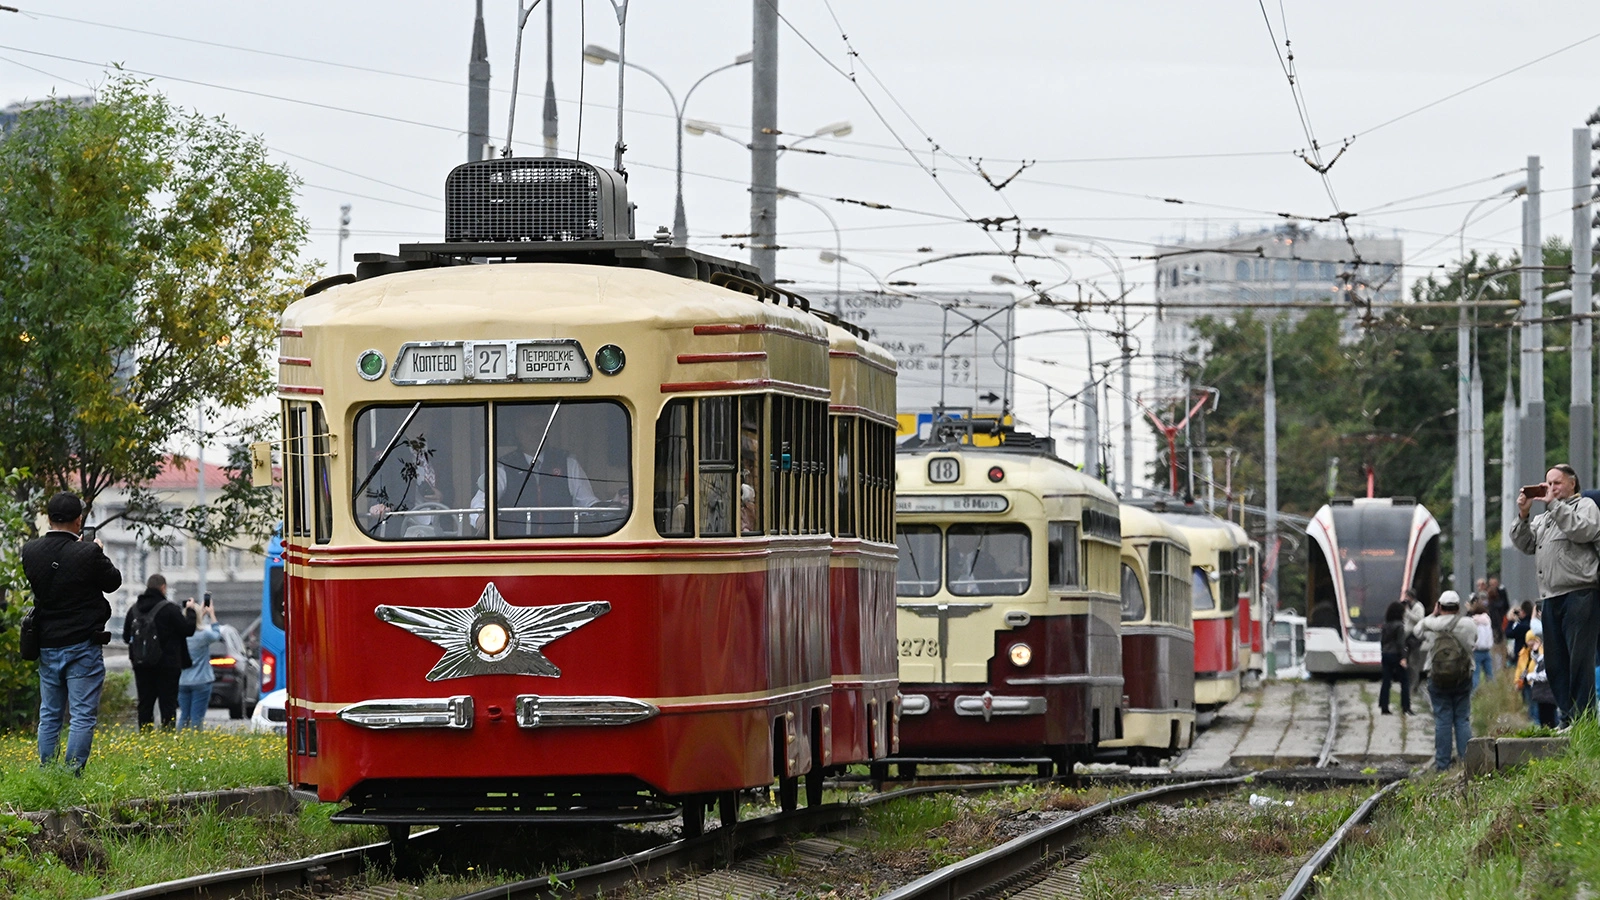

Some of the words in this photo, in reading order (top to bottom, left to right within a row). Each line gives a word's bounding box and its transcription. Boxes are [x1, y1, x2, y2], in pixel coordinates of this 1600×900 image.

[479, 350, 502, 373] 27
[522, 348, 574, 362] ПЕТРОВСКИЕ
[526, 362, 571, 372] ВОРОТА
[897, 359, 924, 370] КОЕ
[935, 461, 953, 480] 18
[897, 638, 938, 658] 278
